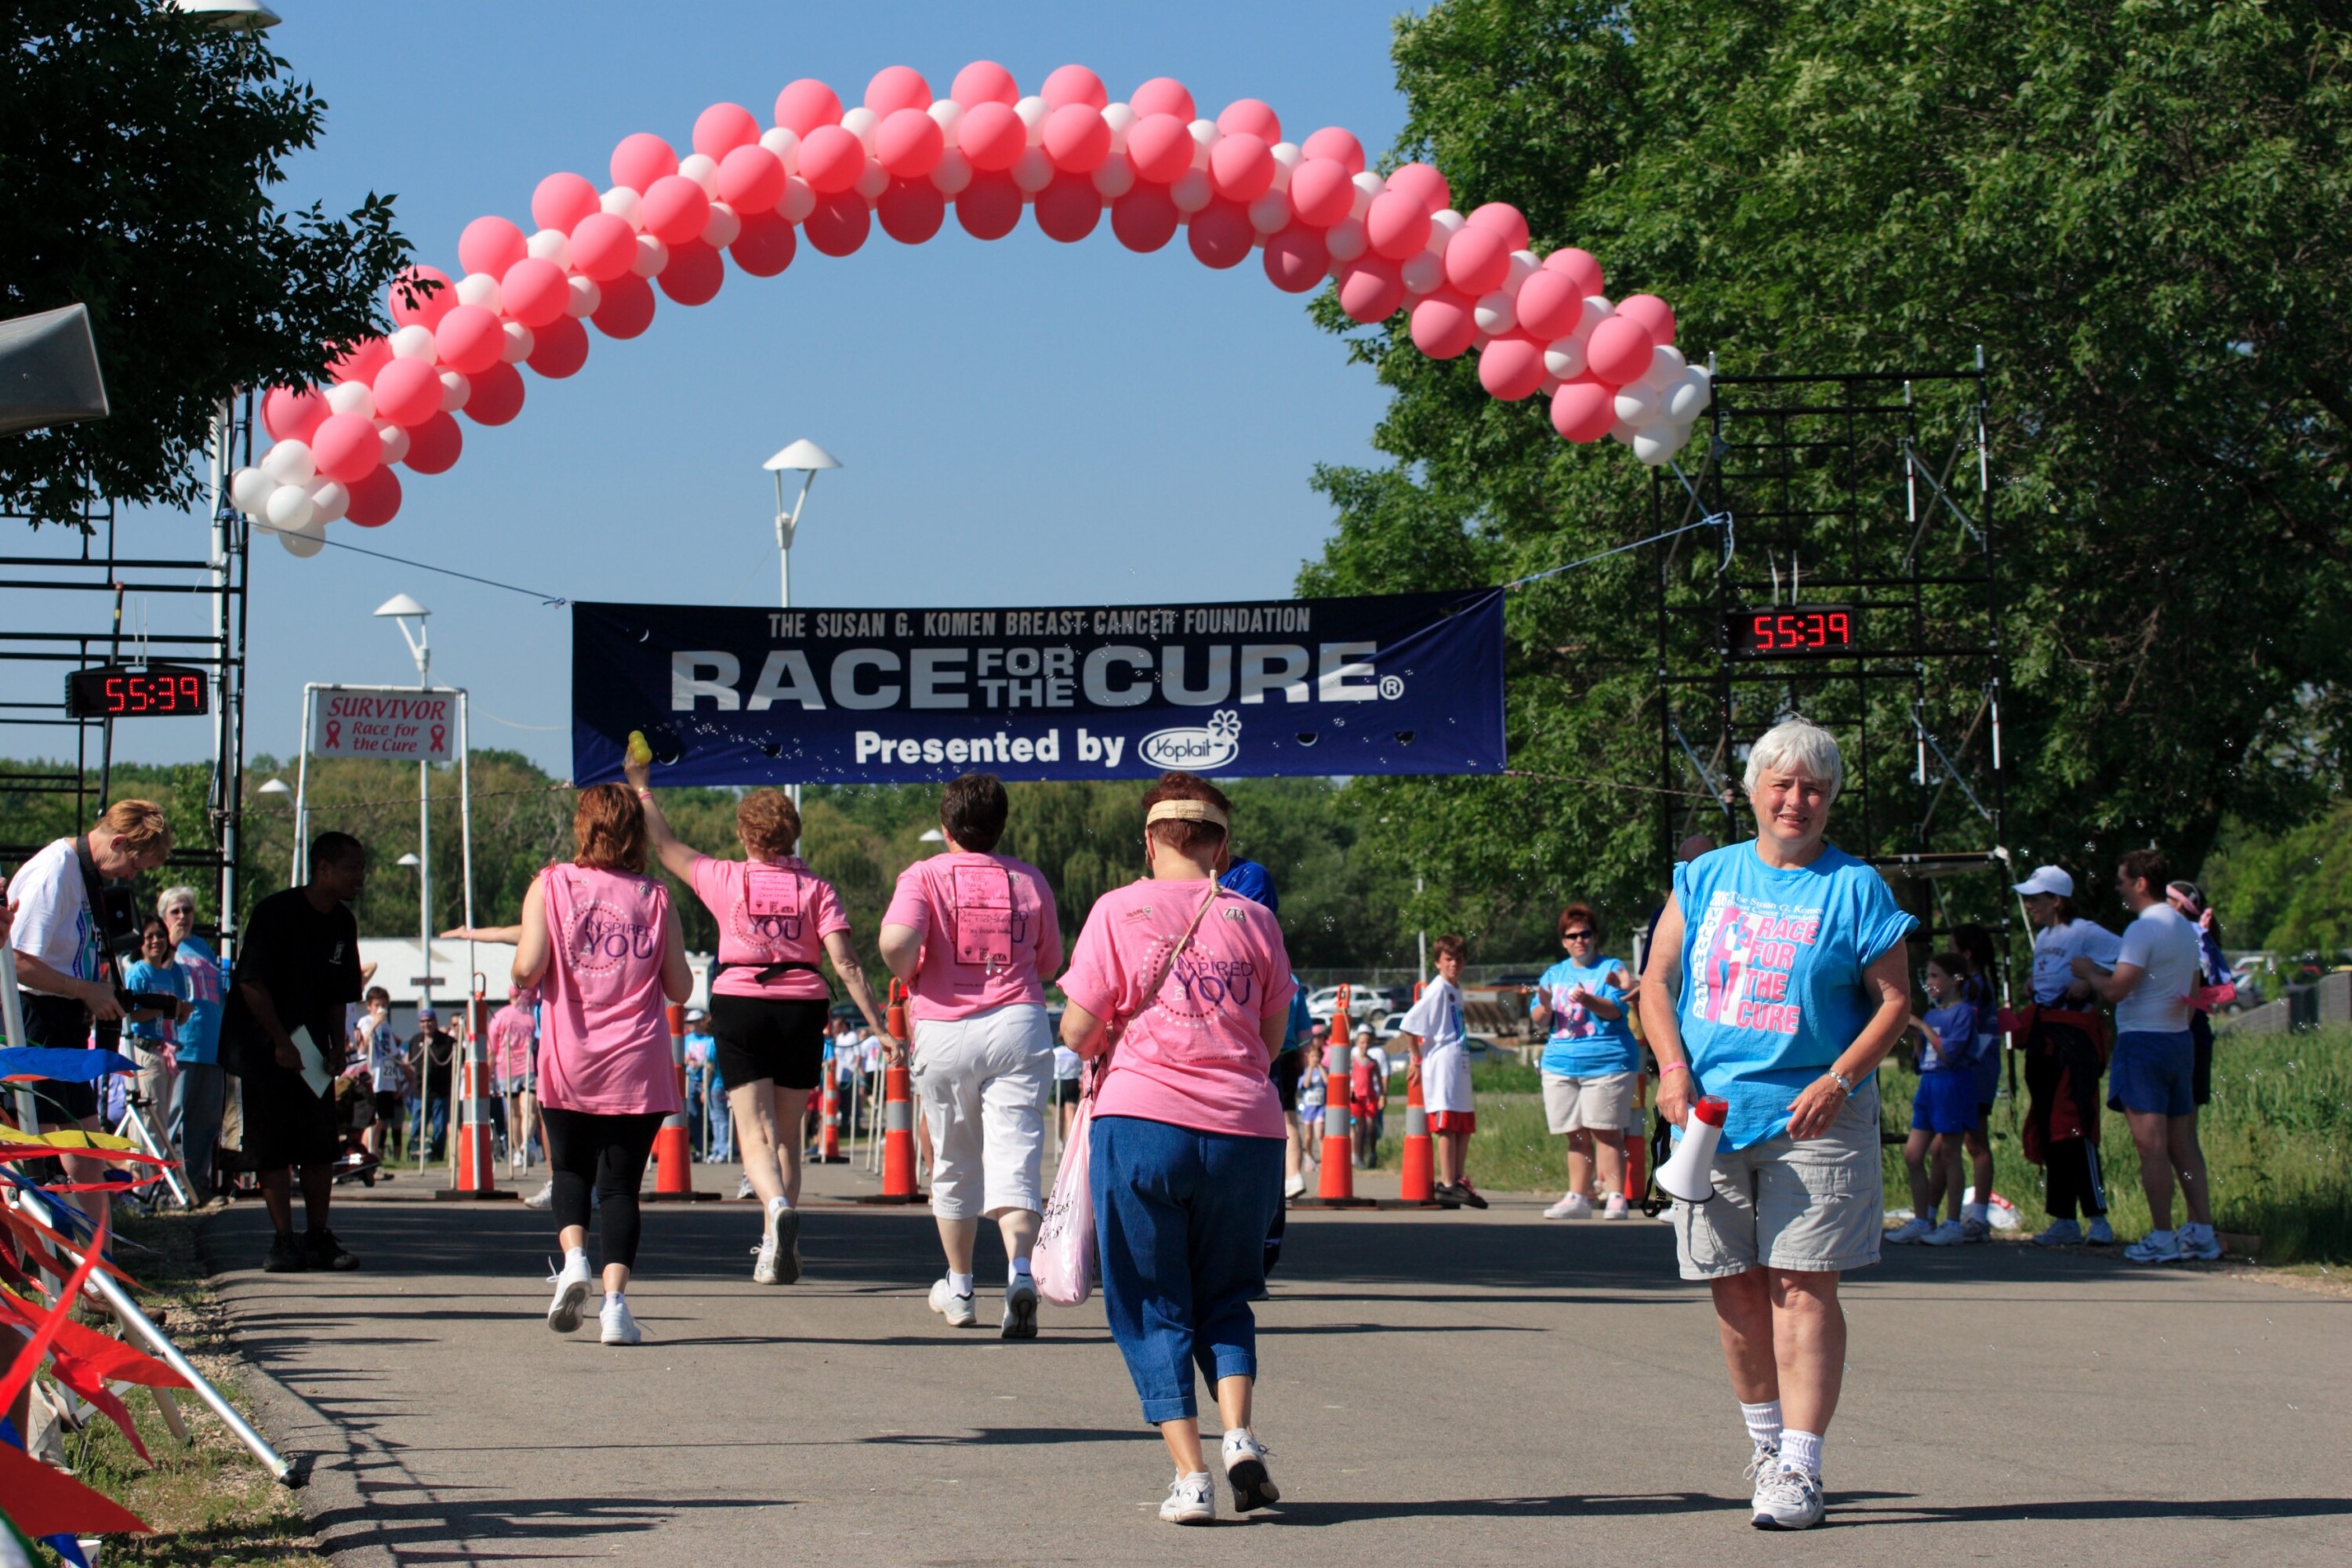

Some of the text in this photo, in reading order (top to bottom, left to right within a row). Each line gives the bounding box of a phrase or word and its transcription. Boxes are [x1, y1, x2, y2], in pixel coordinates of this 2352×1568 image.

[768, 607, 1311, 637] THE SUSAN G. KOMEN BREAST CANCER FOUNDATION
[1755, 613, 1848, 649] 55:39
[978, 647, 1074, 677] FOR
[1083, 640, 1378, 707] CURE
[106, 677, 198, 711] 55:39
[671, 647, 969, 711] RACE
[978, 678, 1074, 708] THE
[327, 696, 446, 720] SURVIVOR
[352, 721, 419, 739] Race for
[353, 737, 417, 753] the Cure
[855, 728, 1212, 768] Presented by Yoplait
[1730, 891, 1748, 903] The
[1751, 898, 1777, 909] Susan
[1779, 904, 1791, 913] G.
[1752, 906, 1779, 916] Cancer
[584, 916, 656, 938] INSPIRED
[747, 916, 802, 941] YOU
[1755, 916, 1820, 946] RACE
[585, 931, 654, 960] YOU
[1746, 939, 1796, 971] FOR
[1173, 969, 1252, 1006] YOU
[1744, 969, 1788, 1000] THE
[1736, 1001, 1801, 1035] CURE
